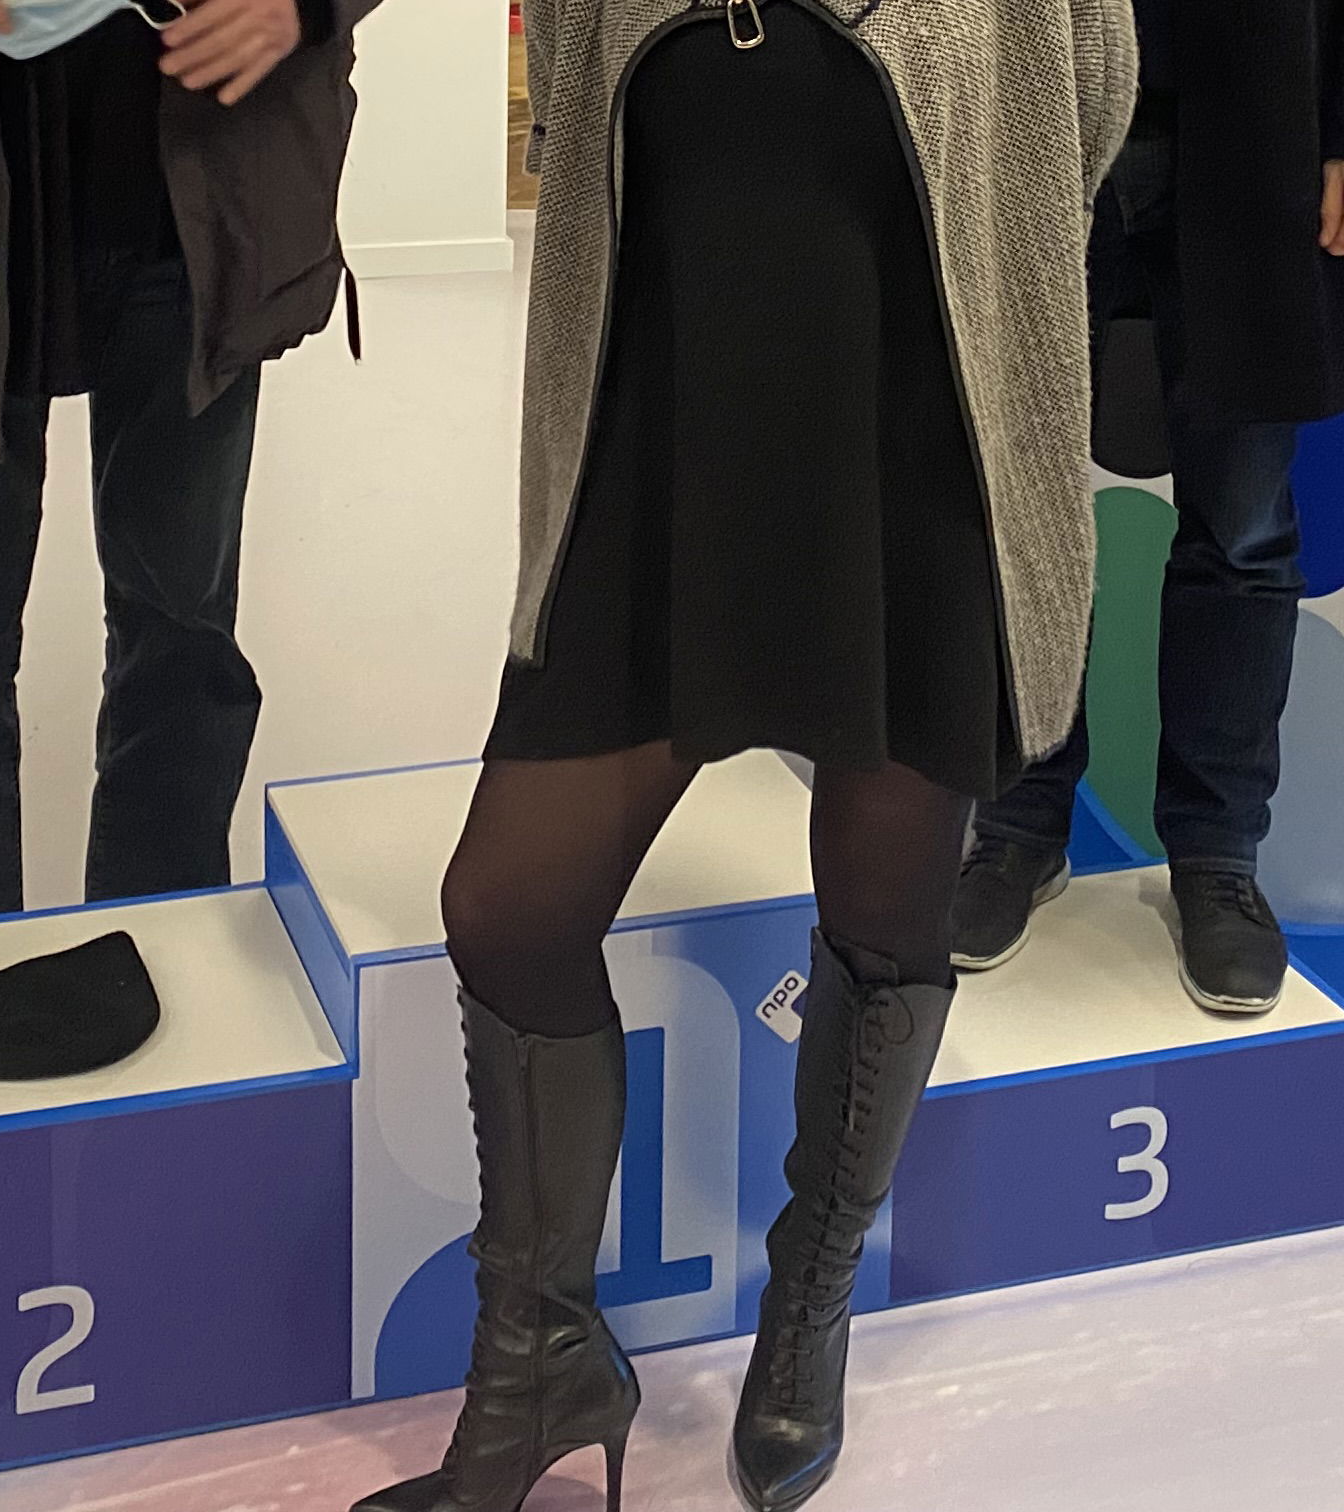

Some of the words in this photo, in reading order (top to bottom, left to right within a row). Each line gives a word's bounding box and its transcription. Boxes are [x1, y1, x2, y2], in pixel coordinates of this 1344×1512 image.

[761, 976, 799, 1019] npo
[1104, 1106, 1169, 1220] 3
[16, 1285, 95, 1415] 2
